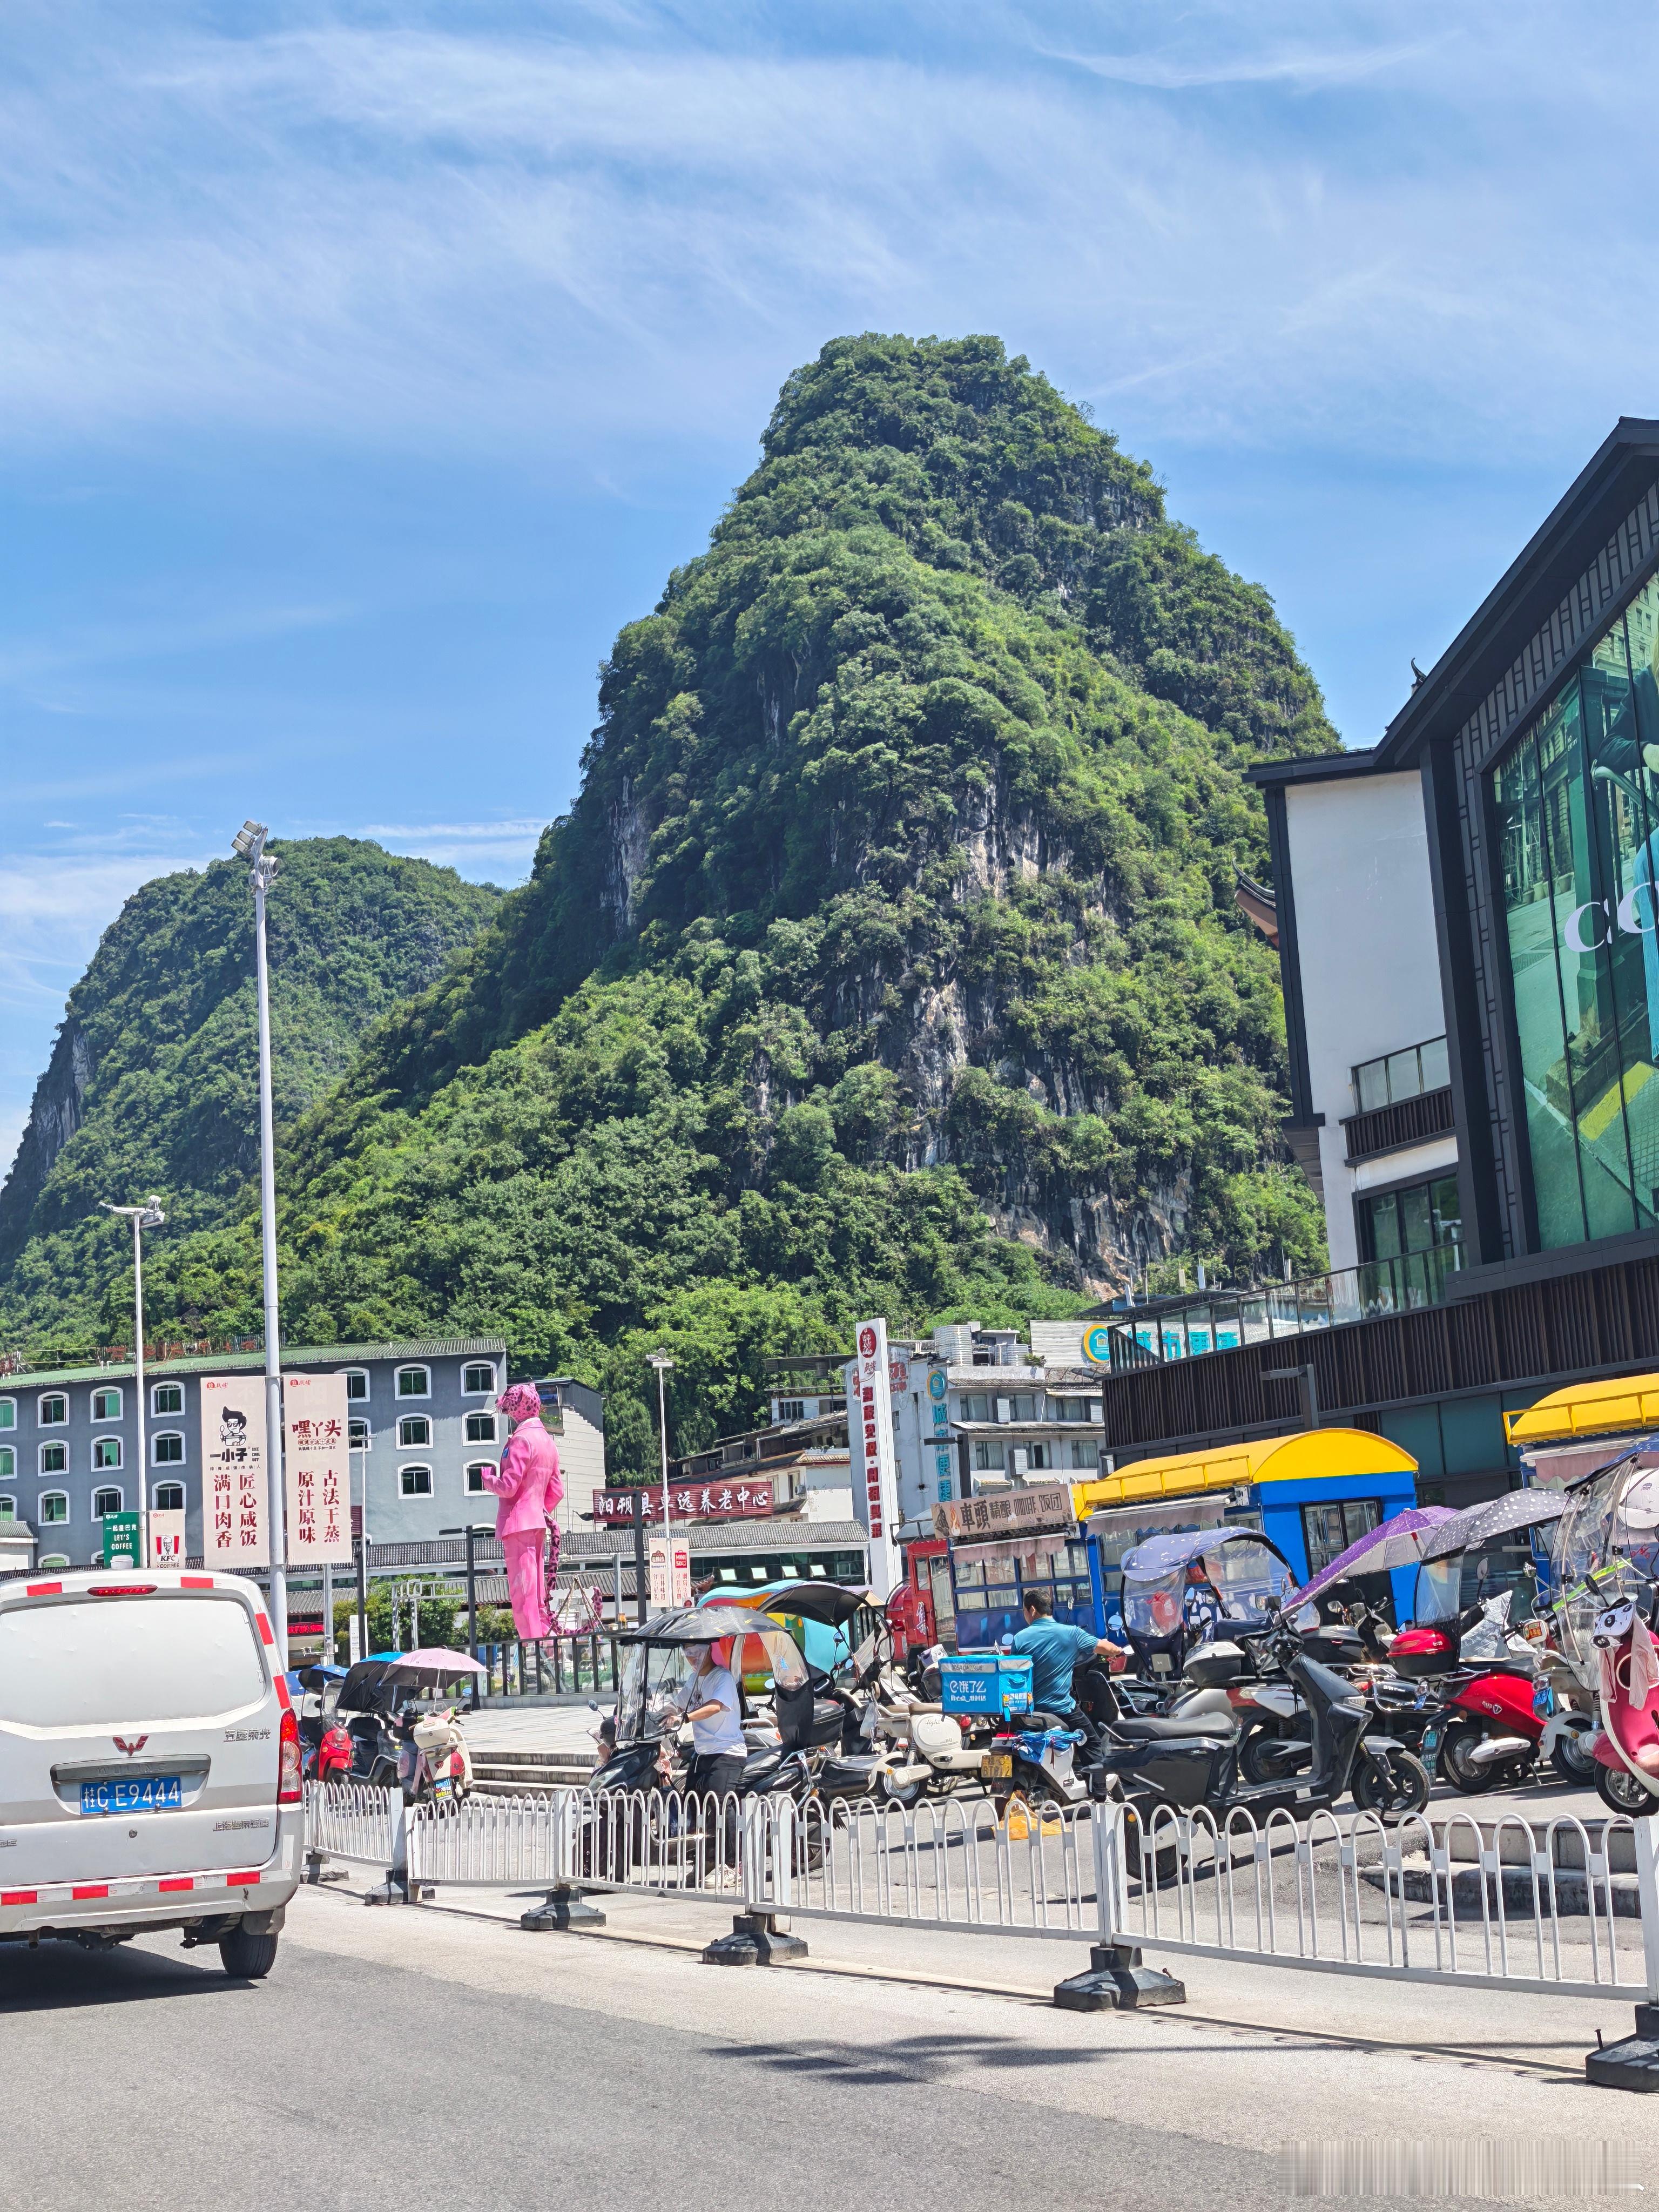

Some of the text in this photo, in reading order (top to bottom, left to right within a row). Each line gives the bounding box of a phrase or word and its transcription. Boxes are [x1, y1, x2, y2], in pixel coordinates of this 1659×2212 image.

[210, 1447, 248, 1462] 一小子
[292, 1419, 342, 1438] 嘿丫头
[214, 1474, 232, 1548] 满口肉香
[239, 1473, 257, 1547] 匠心咸饭
[298, 1471, 316, 1543] 原汁原味
[321, 1469, 340, 1543] 古法干蒸
